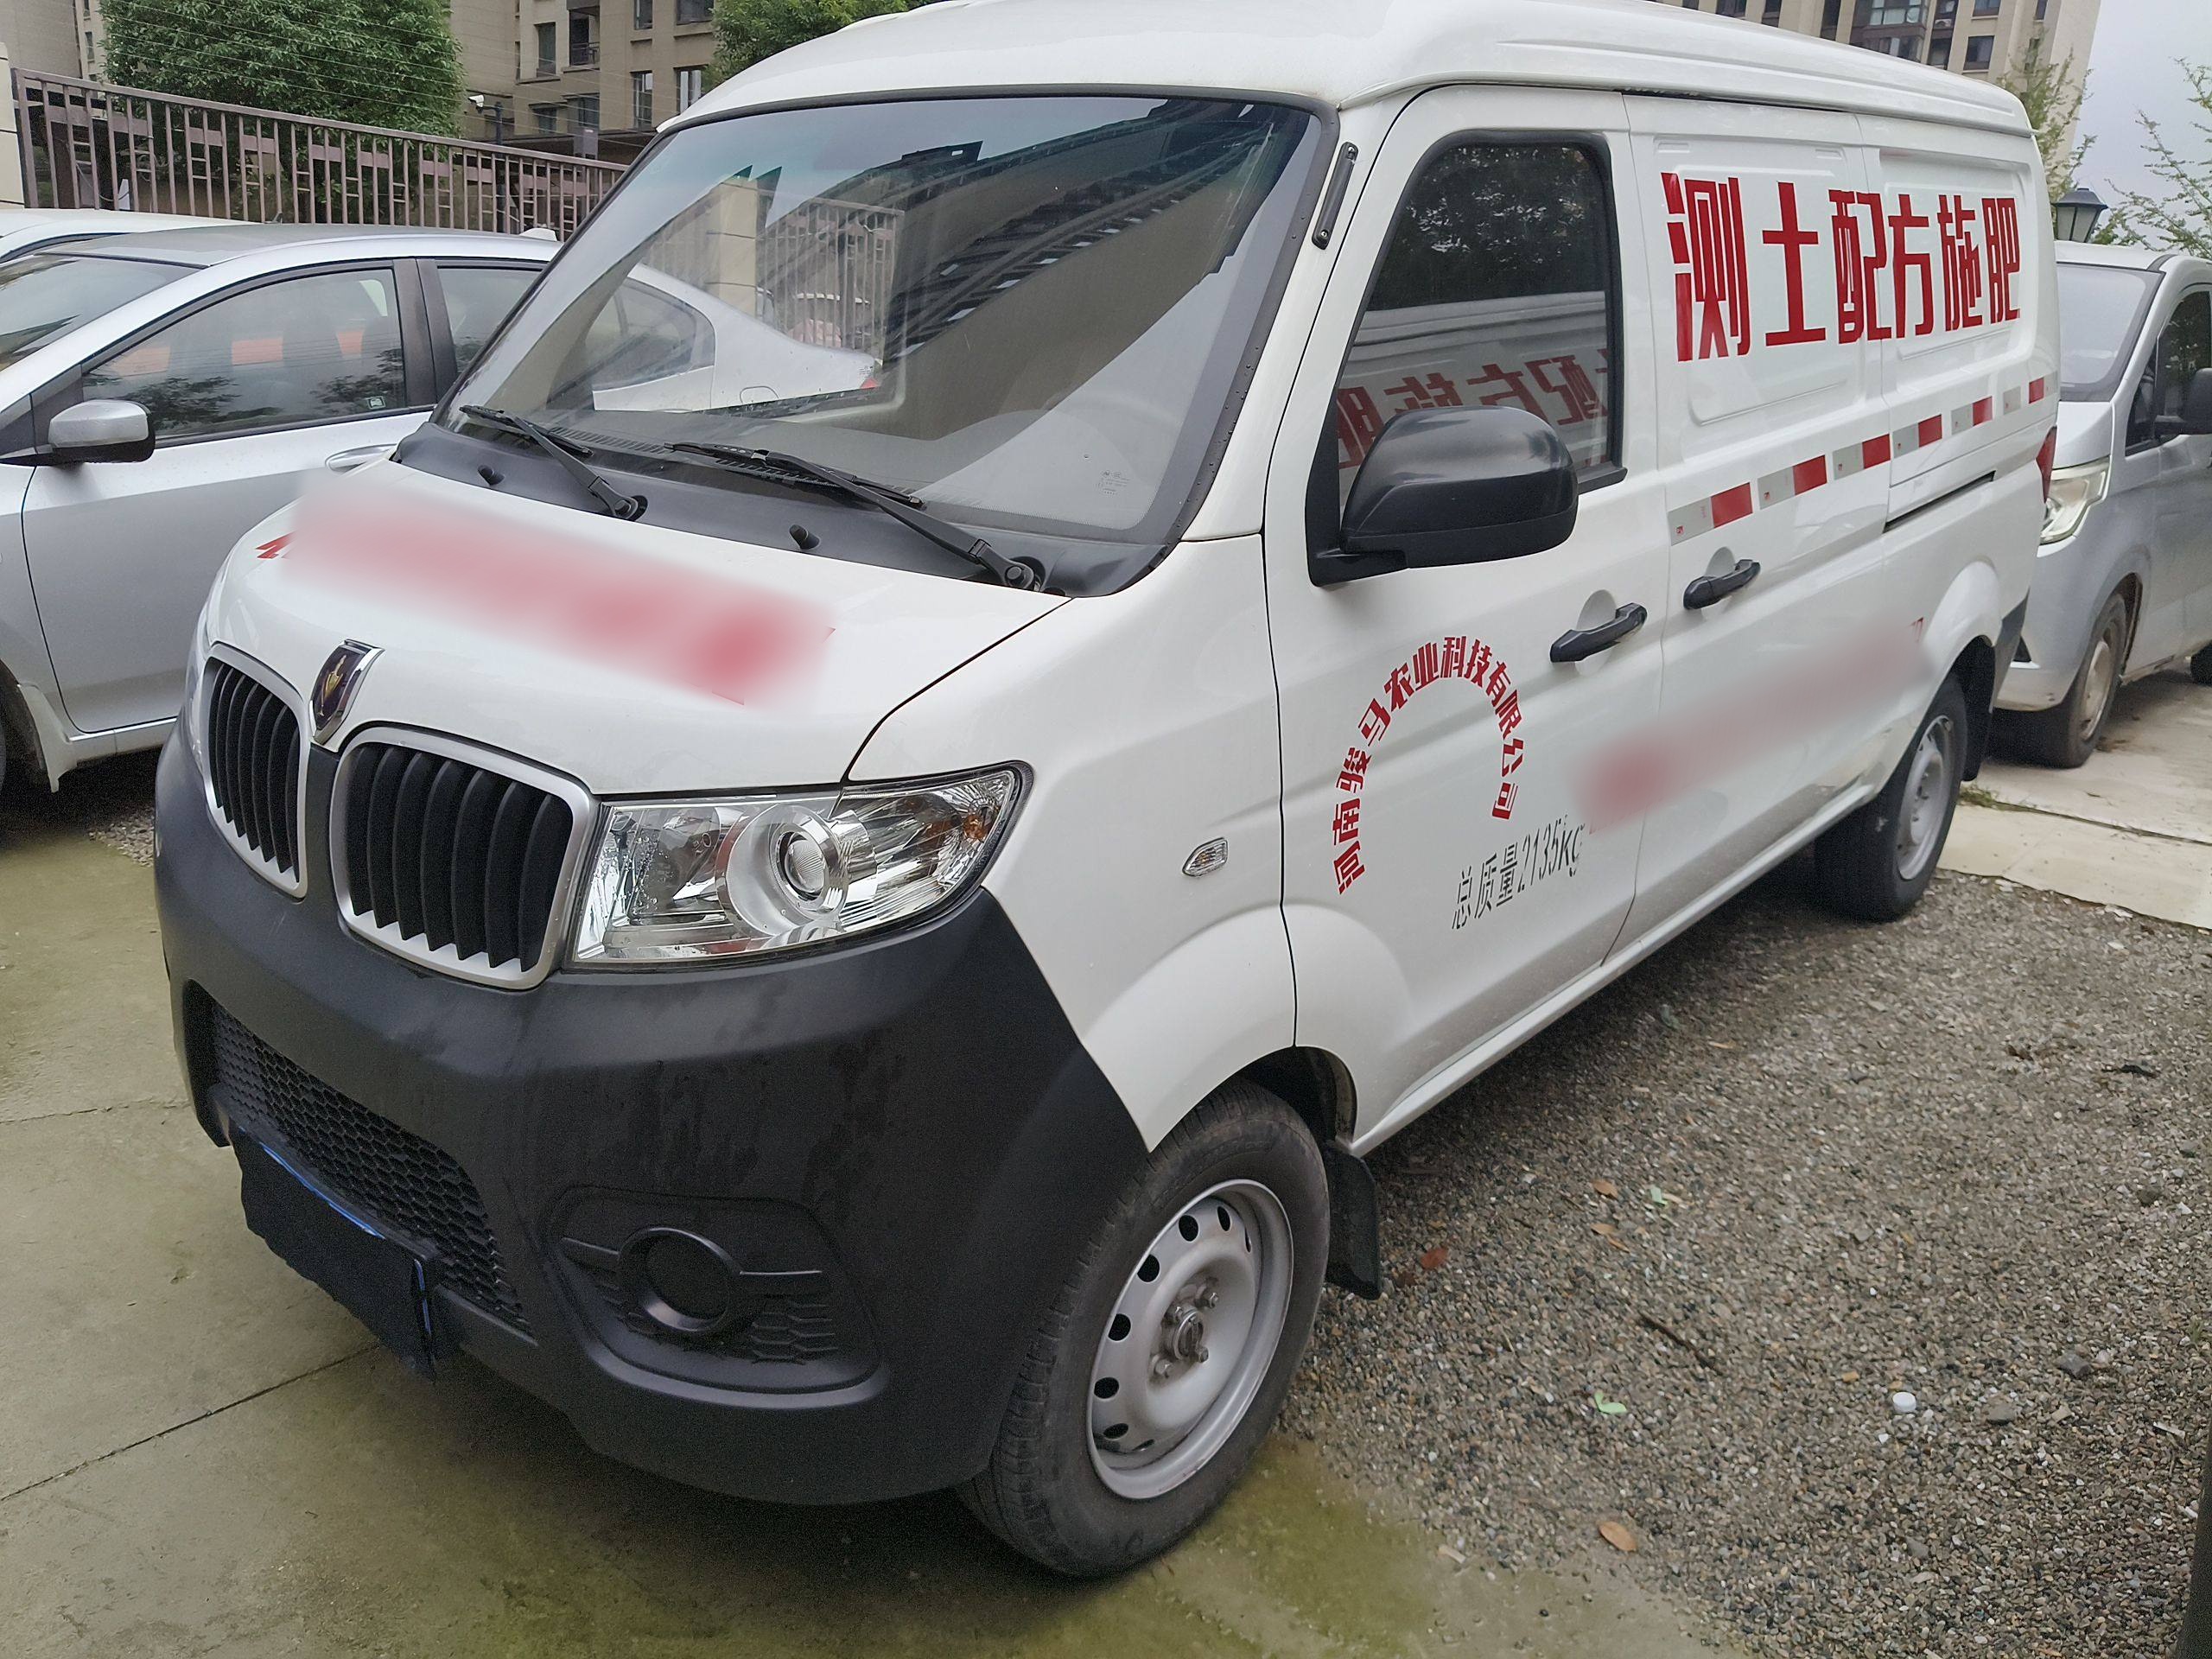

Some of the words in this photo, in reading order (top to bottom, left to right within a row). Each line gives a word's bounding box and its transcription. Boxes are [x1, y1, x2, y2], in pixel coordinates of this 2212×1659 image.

[1661, 172, 2021, 363] 测土配方施肥
[1332, 636, 1524, 895] 河南骏马农业科技有限公司
